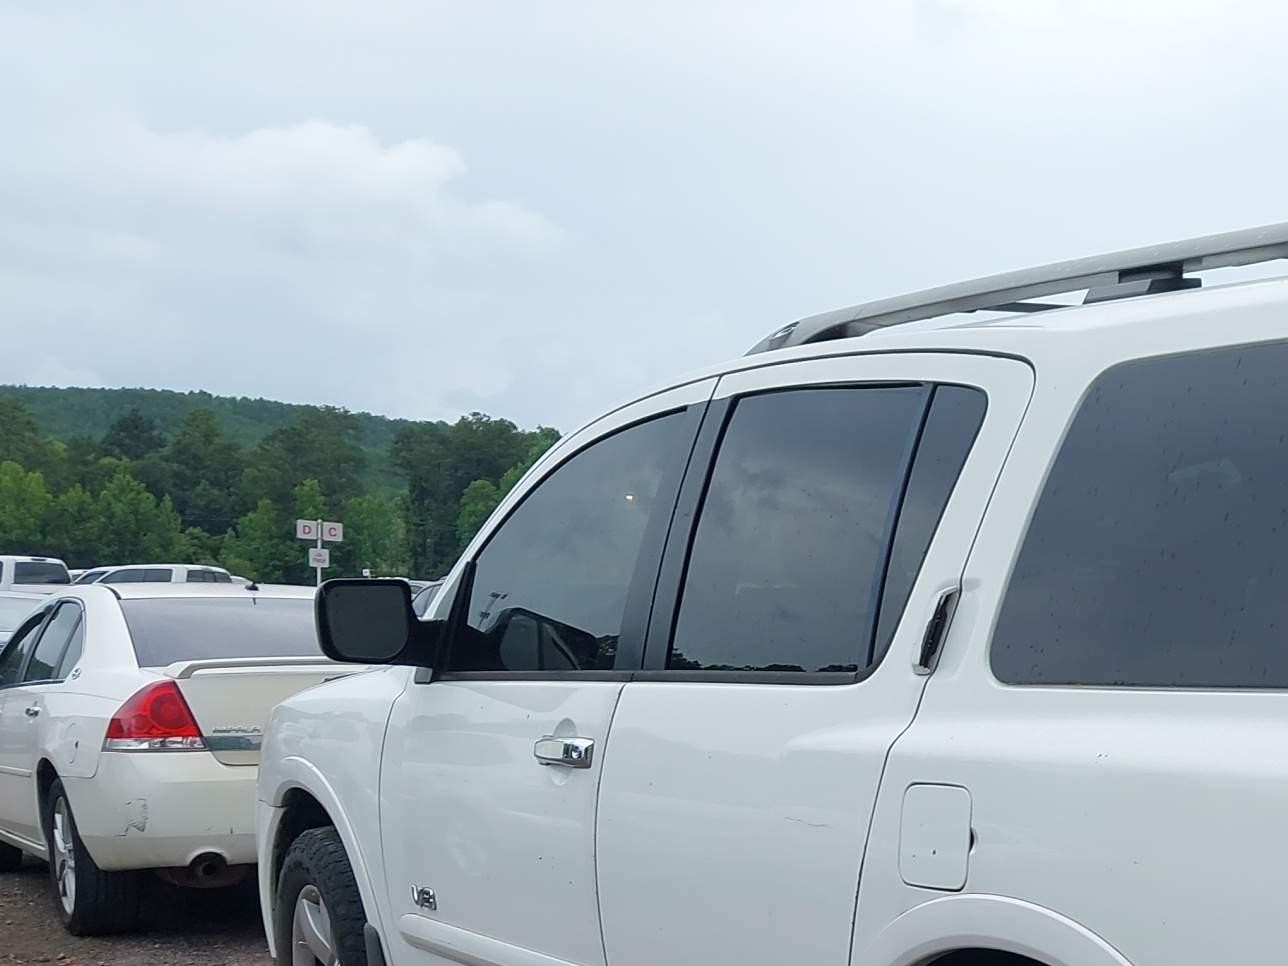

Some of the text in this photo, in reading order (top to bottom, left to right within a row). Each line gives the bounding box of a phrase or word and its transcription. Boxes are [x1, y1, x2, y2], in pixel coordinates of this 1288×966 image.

[302, 525, 312, 535] D
[328, 527, 337, 537] C
[410, 884, 437, 911] V8
